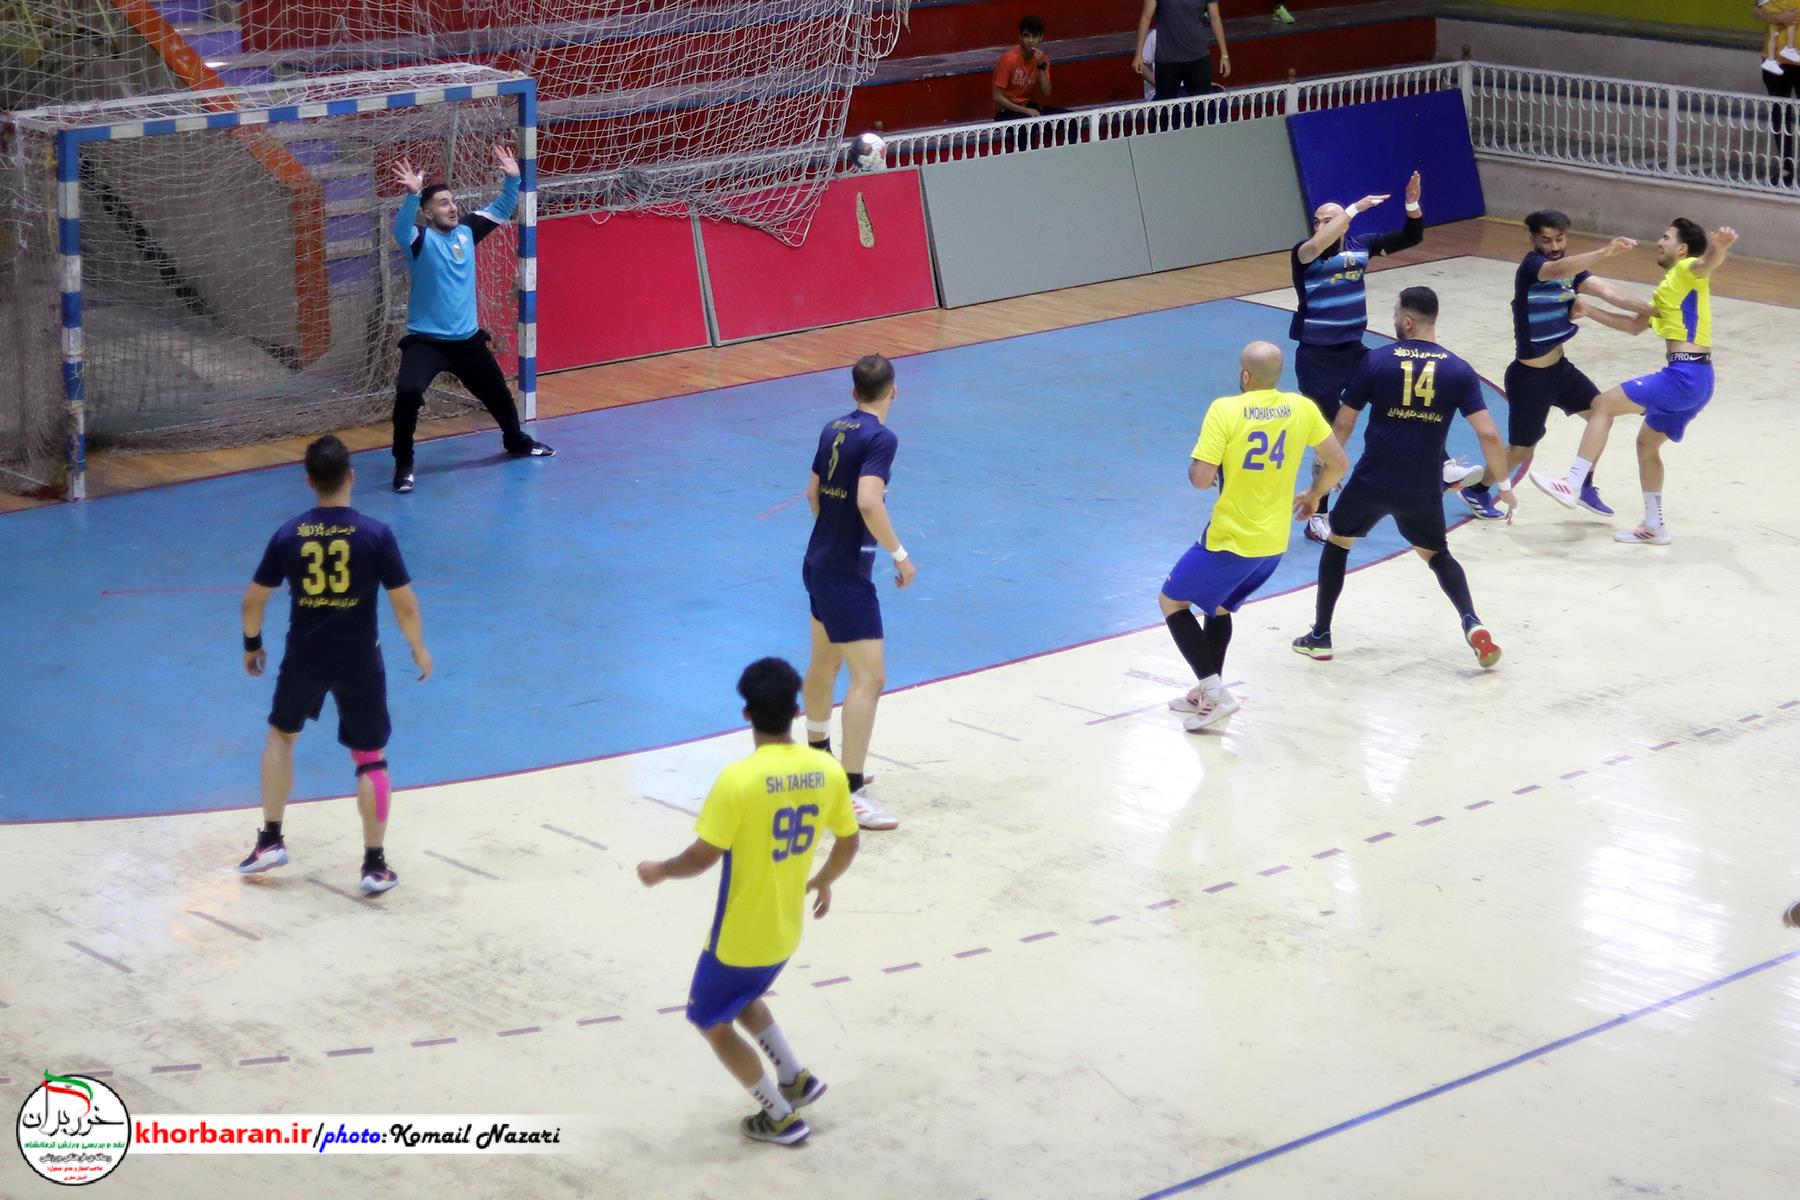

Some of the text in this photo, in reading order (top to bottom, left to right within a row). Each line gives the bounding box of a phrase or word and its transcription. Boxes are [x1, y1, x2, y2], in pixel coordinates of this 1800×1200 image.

[1674, 353, 1690, 361] PRO
[1400, 360, 1436, 407] 14
[1242, 429, 1287, 471] 24
[301, 539, 350, 596] 33
[772, 803, 820, 863] 96
